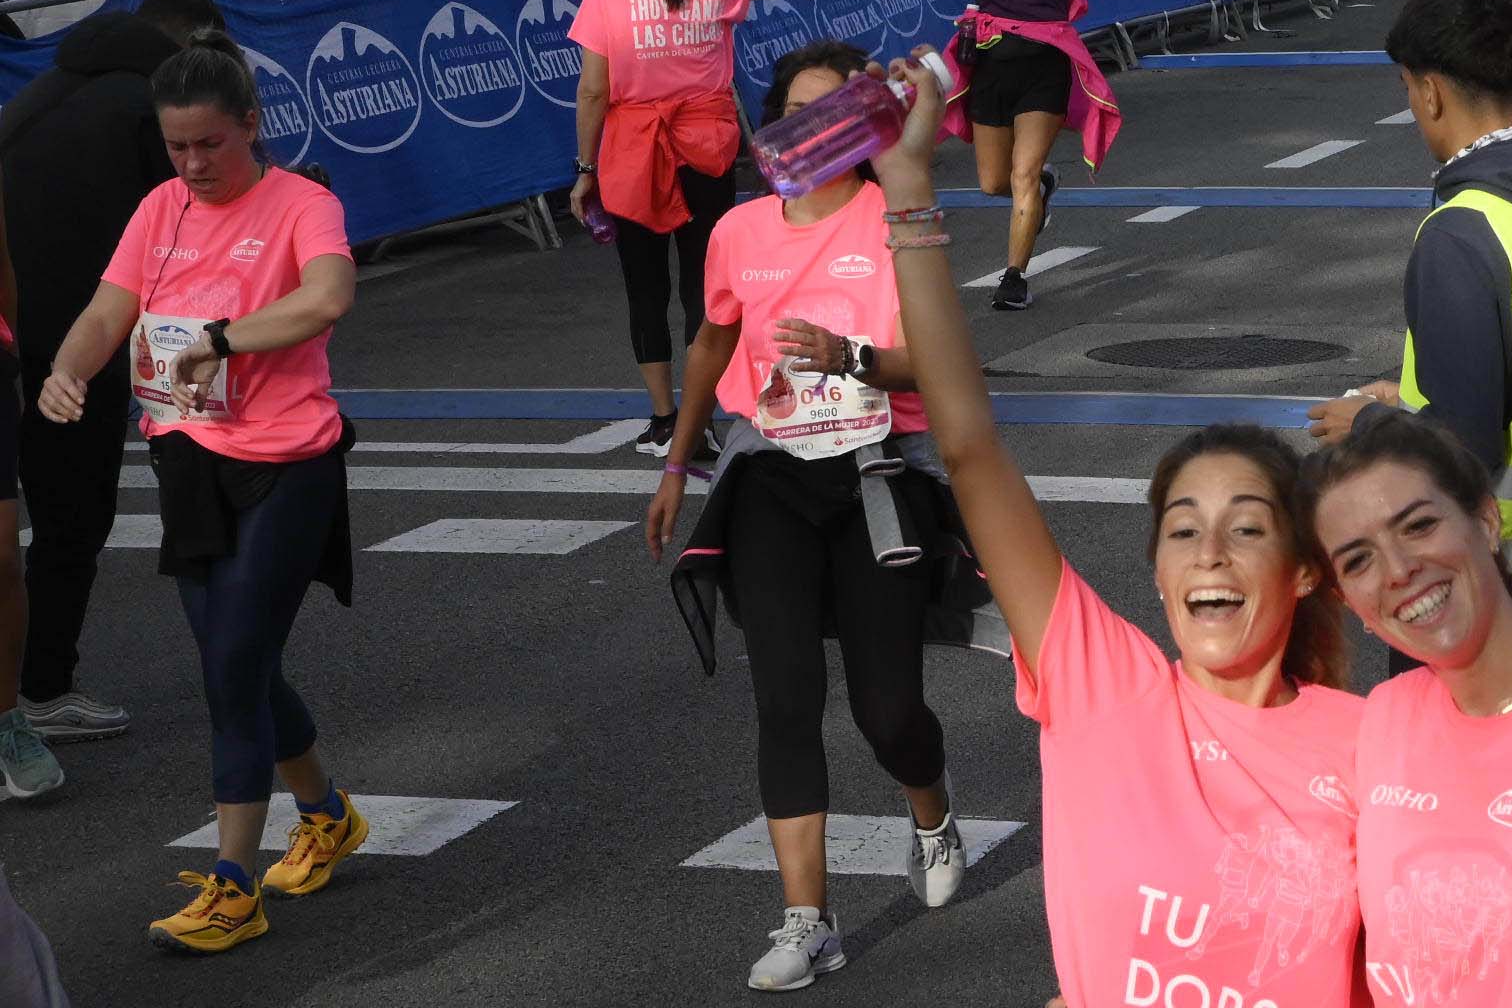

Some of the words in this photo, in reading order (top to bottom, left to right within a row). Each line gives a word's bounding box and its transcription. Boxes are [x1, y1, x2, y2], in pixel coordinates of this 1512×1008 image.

[633, 24, 666, 49] LAS
[430, 53, 520, 101] ASTURIANA
[319, 77, 416, 127] ASTURIANA
[153, 246, 199, 261] OYSHO
[800, 386, 842, 405] 016
[810, 407, 838, 420] 9600
[776, 426, 811, 437] CARRERA
[824, 422, 833, 430] LA
[835, 421, 859, 429] MUJER
[1138, 885, 1210, 948] TU
